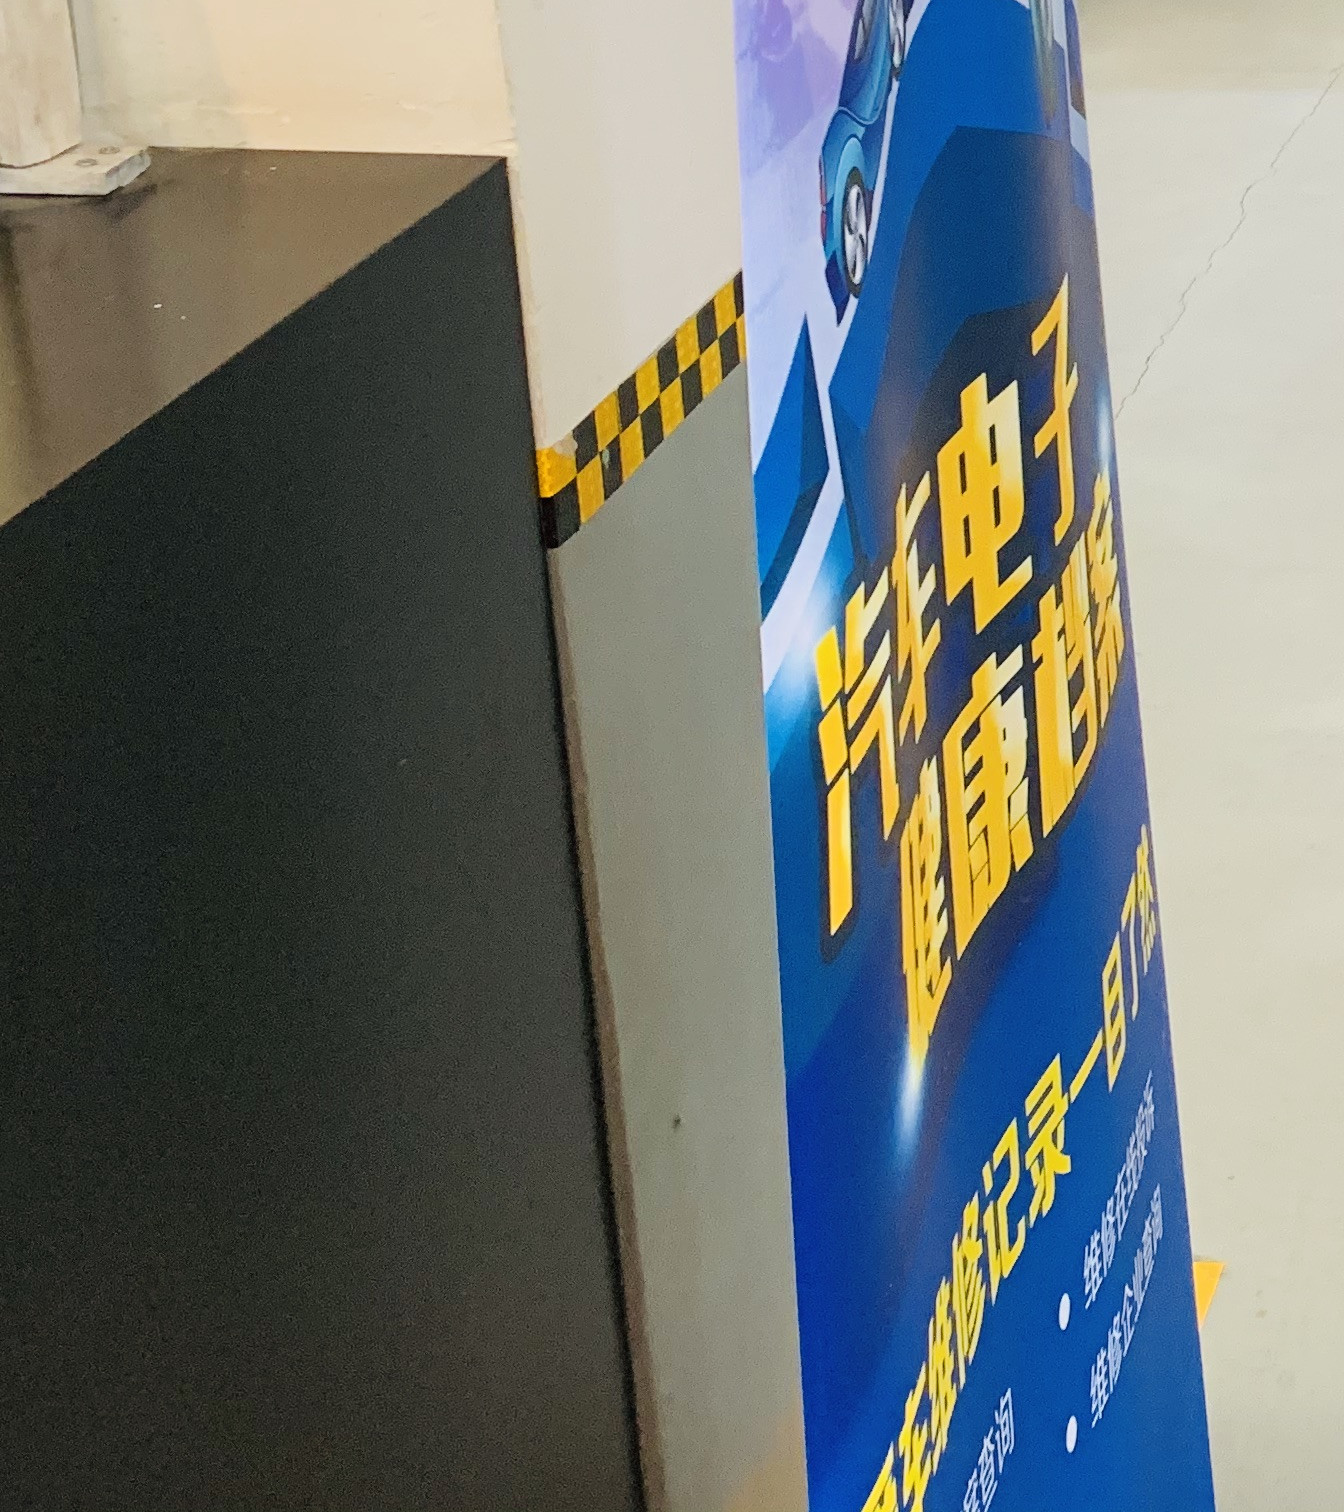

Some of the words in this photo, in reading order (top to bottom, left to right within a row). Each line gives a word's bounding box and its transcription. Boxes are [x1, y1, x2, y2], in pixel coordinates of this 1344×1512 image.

[815, 273, 1079, 936] 汽车电子
[900, 471, 1126, 1058] 健康档案
[1090, 1183, 1163, 1428] 维修企业查询
